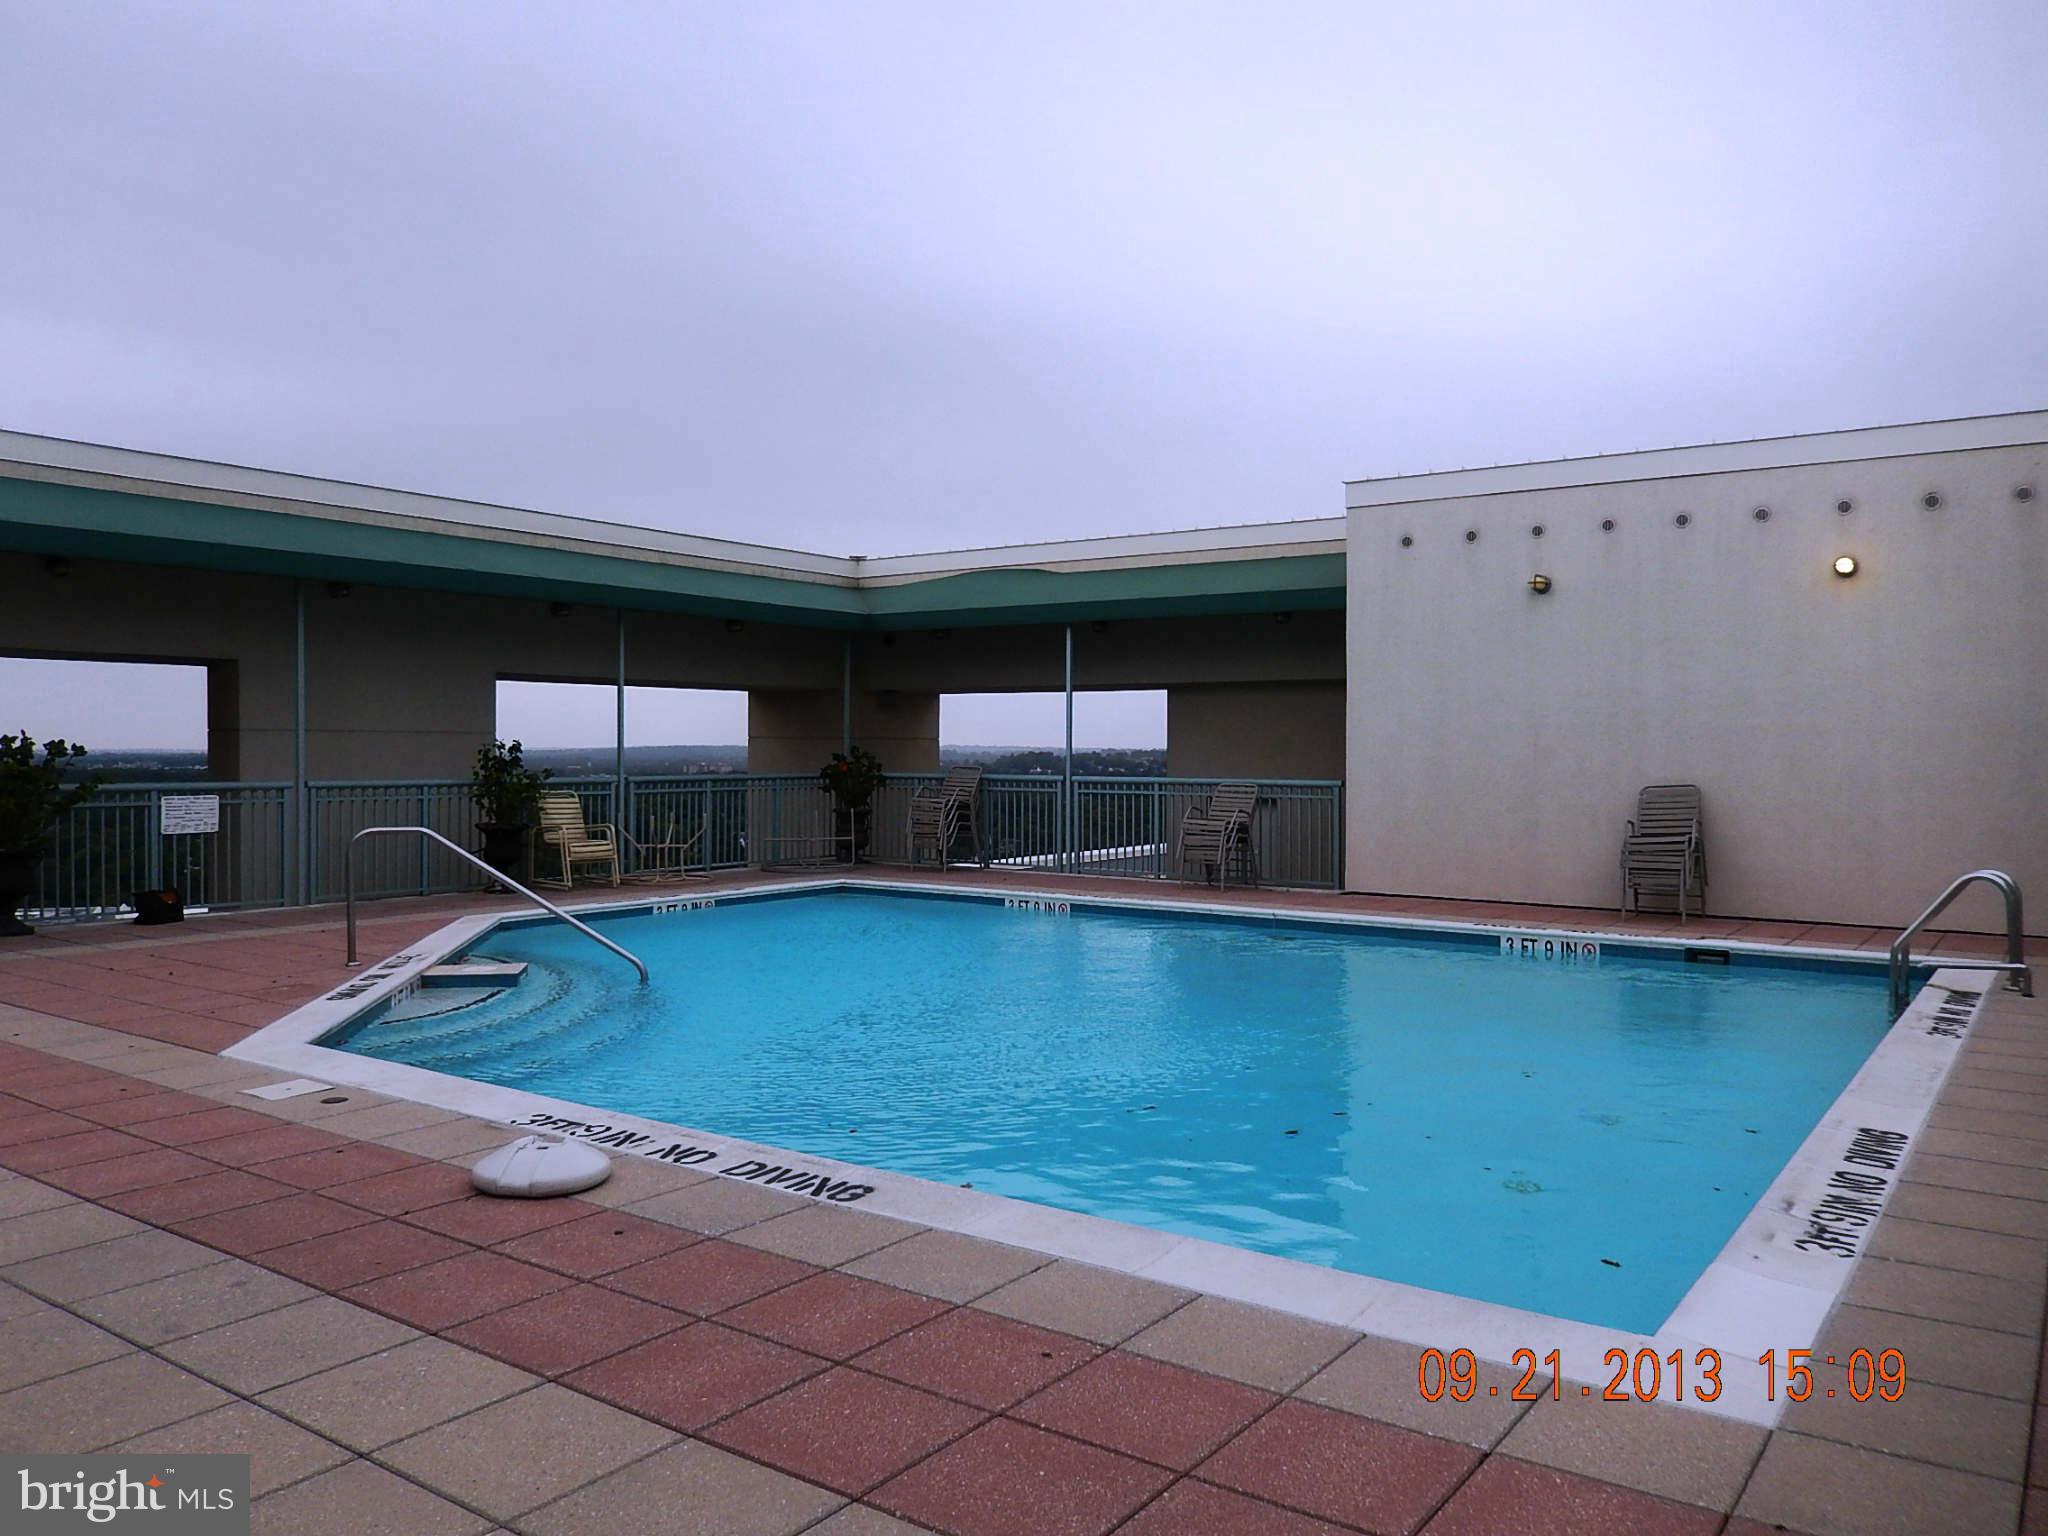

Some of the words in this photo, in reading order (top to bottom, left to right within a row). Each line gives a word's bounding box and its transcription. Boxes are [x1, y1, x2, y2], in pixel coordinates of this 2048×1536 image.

[1521, 938, 1538, 953] FT
[1560, 941, 1577, 955] IN
[1843, 1127, 1909, 1170] DIVING
[644, 1143, 717, 1165] NO
[718, 1160, 875, 1202] DIVING
[1827, 1171, 1888, 1196] NO
